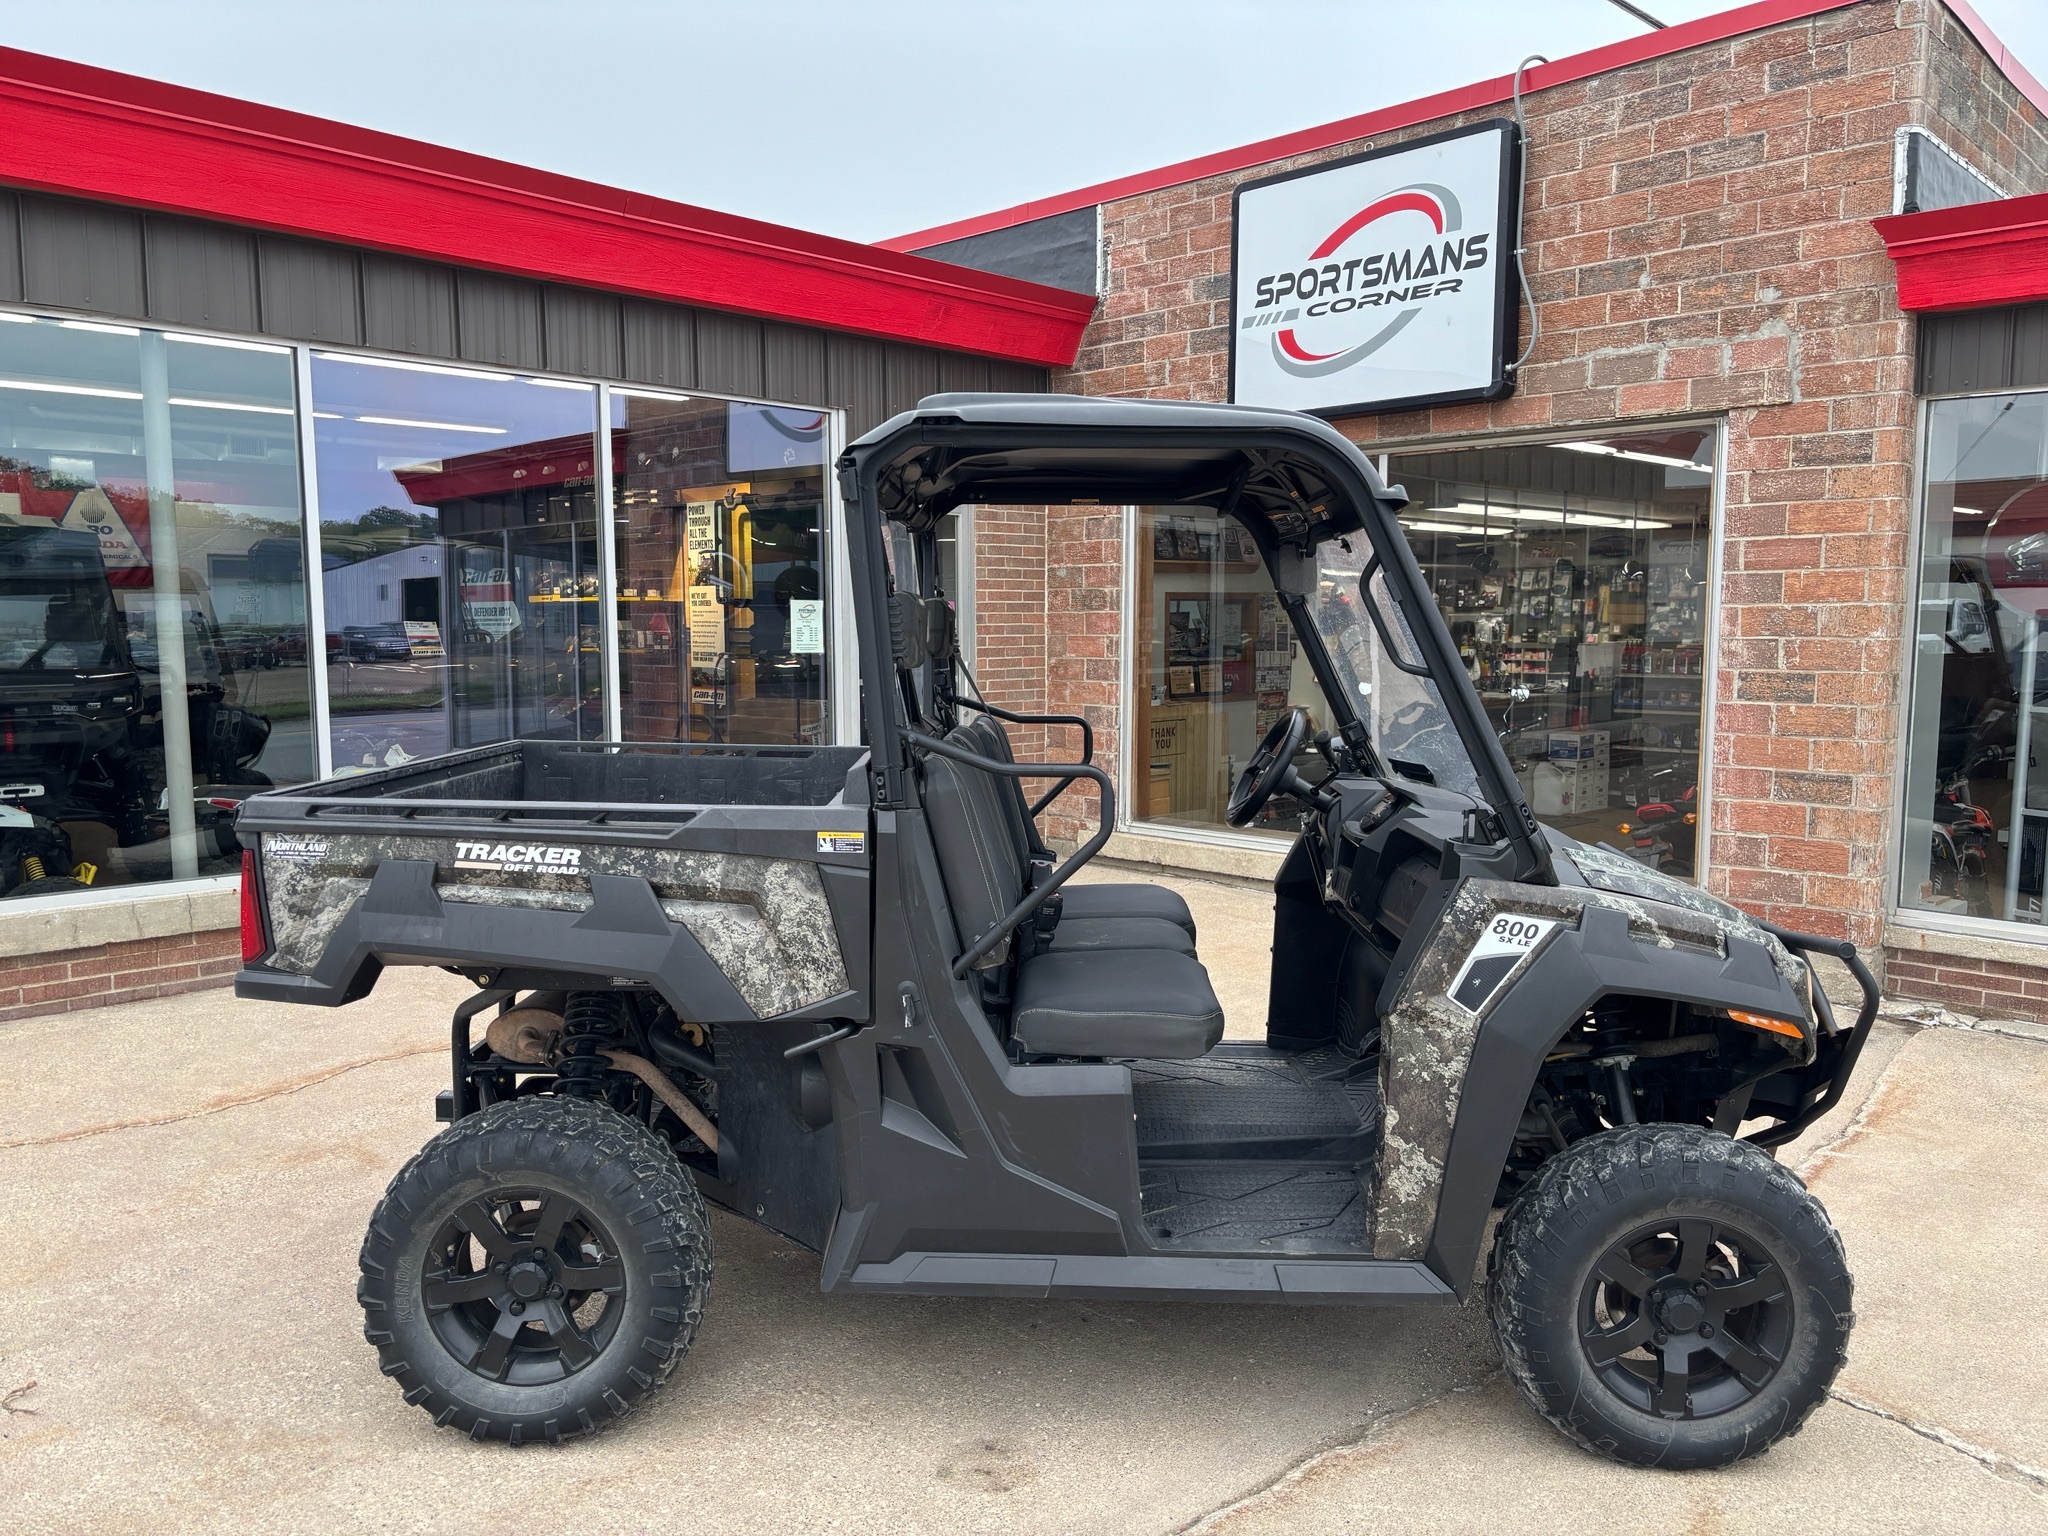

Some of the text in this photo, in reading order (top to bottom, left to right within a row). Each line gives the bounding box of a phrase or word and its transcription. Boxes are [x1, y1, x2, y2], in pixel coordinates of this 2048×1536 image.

[1254, 233, 1490, 308] SPORTSMANS
[1306, 278, 1464, 317] CORNER
[688, 505, 706, 516] POWER
[689, 516, 711, 528] THROUGH
[689, 528, 707, 539] ALL THE
[689, 539, 714, 550] ELEMENTS
[693, 690, 724, 700] can-am
[1150, 726, 1176, 739] THANK
[1155, 739, 1171, 749] YOU
[455, 842, 582, 866] TRACKER
[503, 863, 580, 875] OFF ROAD
[1492, 919, 1540, 940] 800
[1498, 935, 1532, 947] SX LE
[395, 1256, 415, 1324] KENDA
